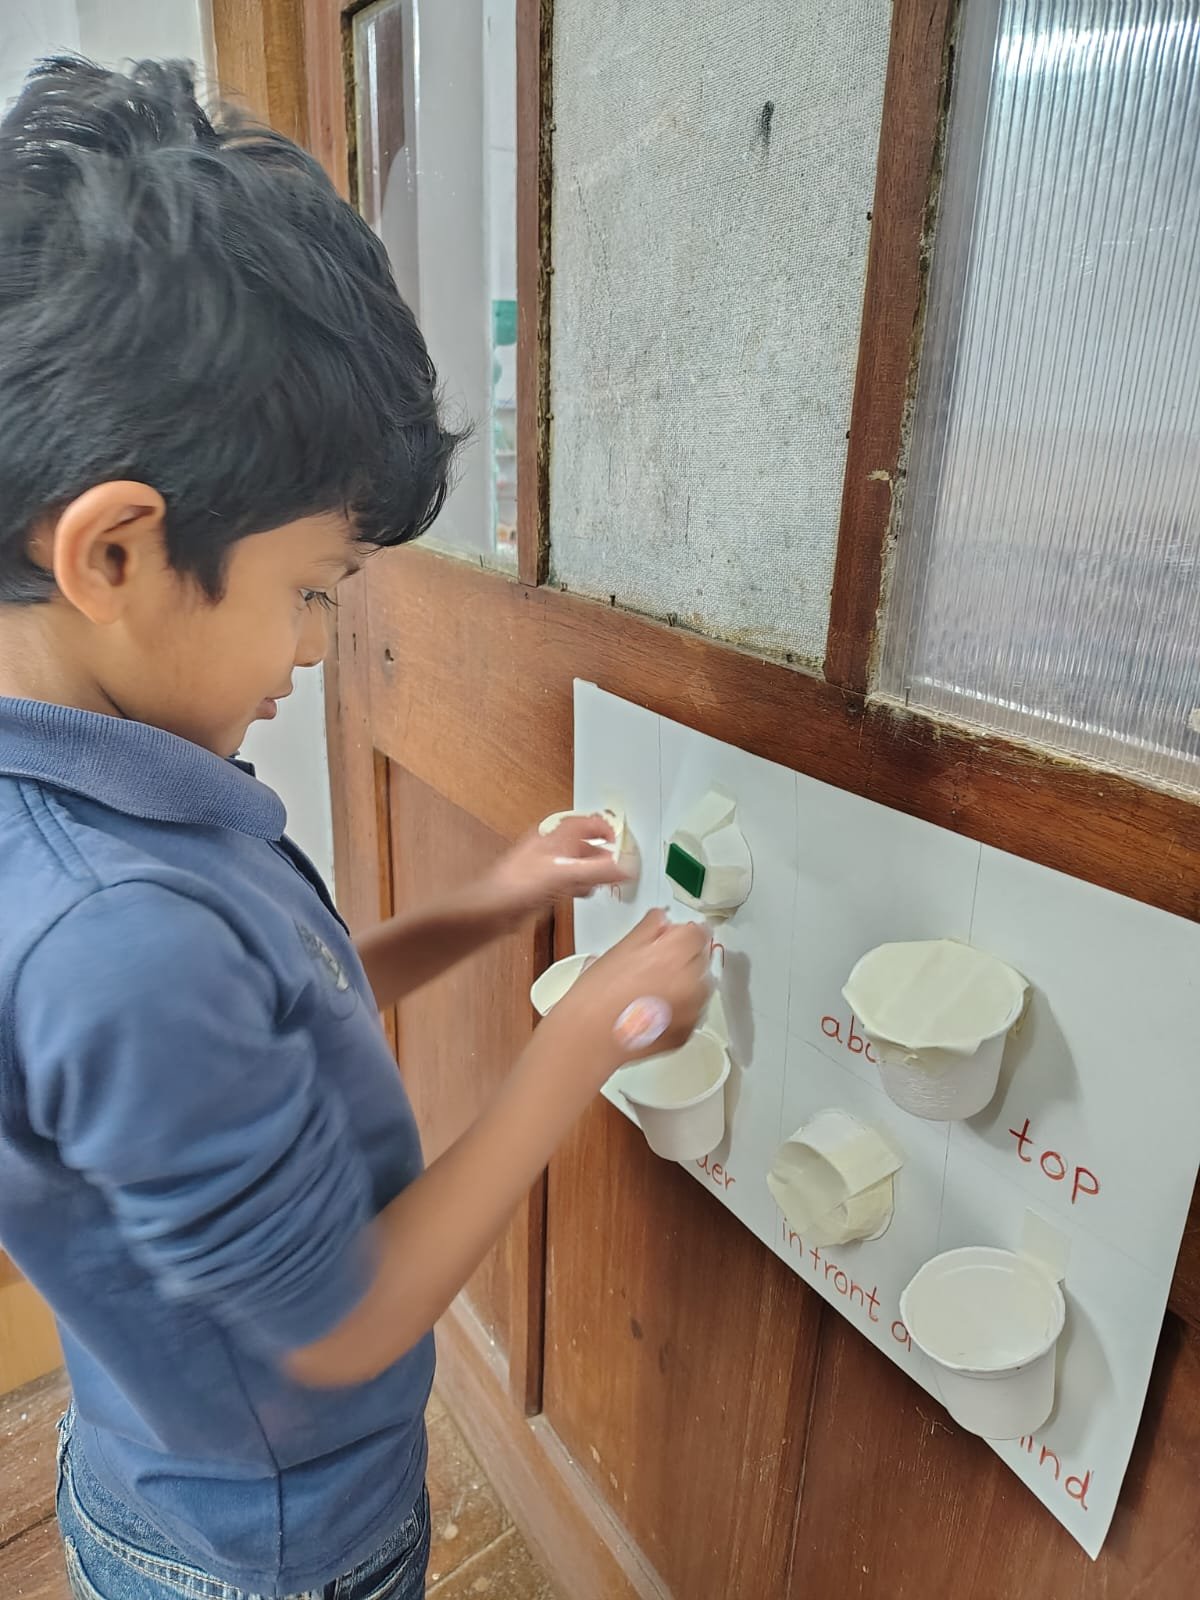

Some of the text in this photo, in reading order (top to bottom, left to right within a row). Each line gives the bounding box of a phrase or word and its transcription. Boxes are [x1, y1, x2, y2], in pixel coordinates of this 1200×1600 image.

[695, 1154, 736, 1191] der
[1008, 1118, 1099, 1205] top
[782, 1217, 803, 1258] in
